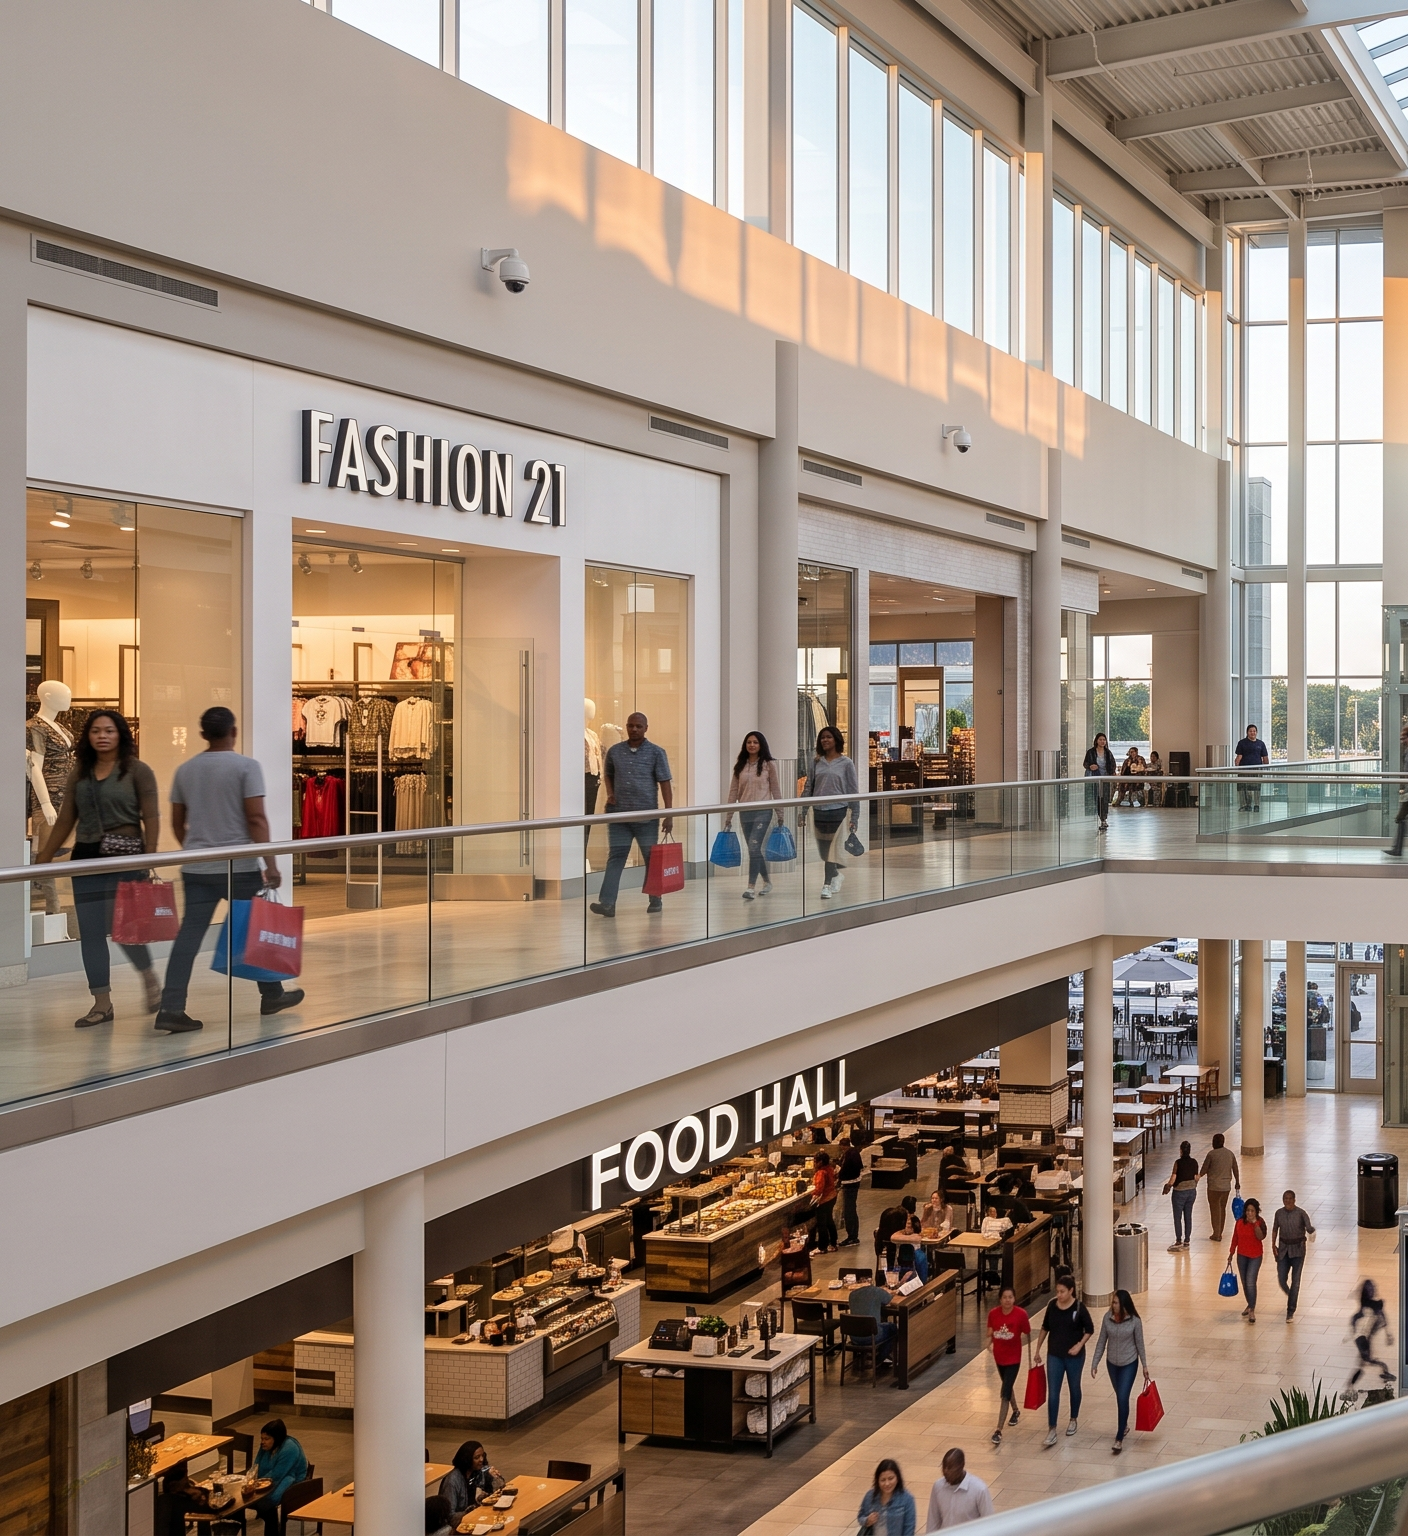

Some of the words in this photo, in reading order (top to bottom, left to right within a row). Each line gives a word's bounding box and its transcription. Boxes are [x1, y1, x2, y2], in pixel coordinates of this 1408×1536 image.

[301, 409, 514, 518] FASHION
[523, 458, 567, 527] 21
[591, 1103, 739, 1212] FOOD
[754, 1058, 858, 1144] HALL
